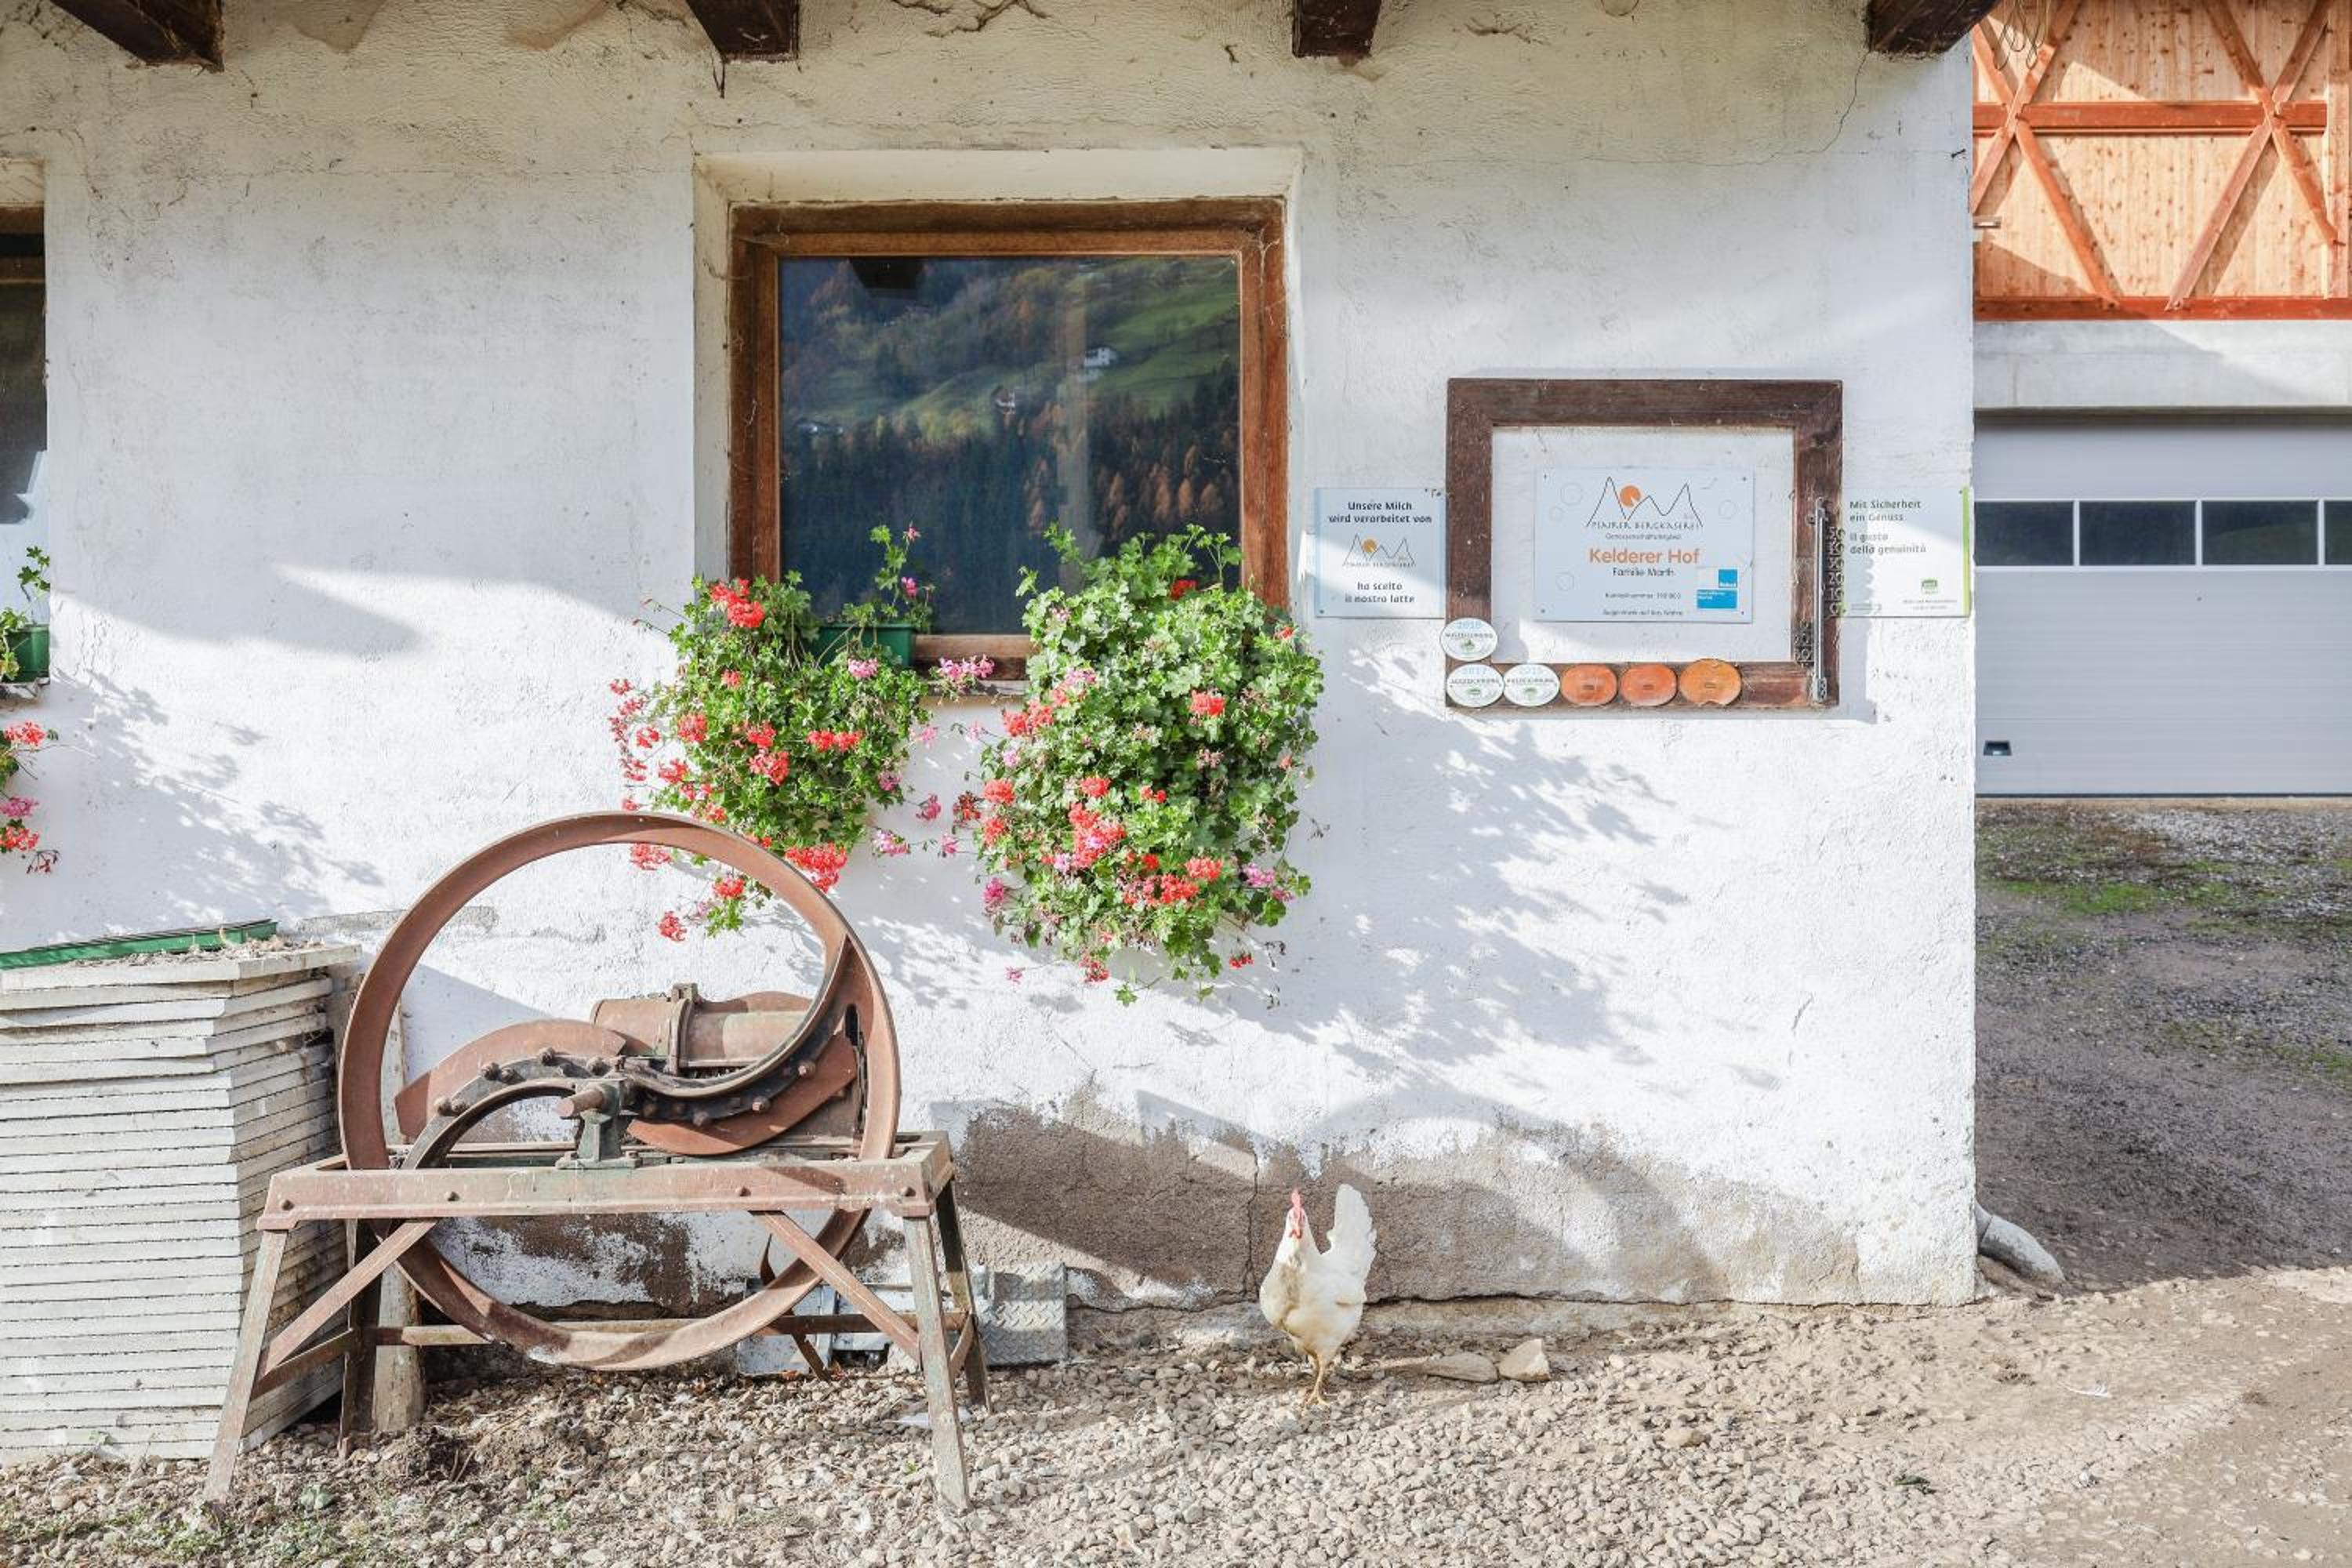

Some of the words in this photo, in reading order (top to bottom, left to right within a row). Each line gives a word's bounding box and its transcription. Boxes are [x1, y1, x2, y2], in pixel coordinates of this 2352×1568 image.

[1348, 501, 1382, 510] Unsere
[1385, 501, 1412, 510] Milch
[1870, 500, 1921, 509] Sicherheit
[1329, 514, 1351, 523] wird
[1354, 514, 1410, 523] verarbeitet
[1860, 533, 1889, 543] gusto
[1850, 545, 1875, 554] della
[1589, 547, 1662, 564] Kelderer
[1668, 547, 1700, 564] Hof
[1613, 567, 1644, 576] Familie
[1373, 582, 1403, 590] scelto
[1390, 594, 1415, 603] latte
